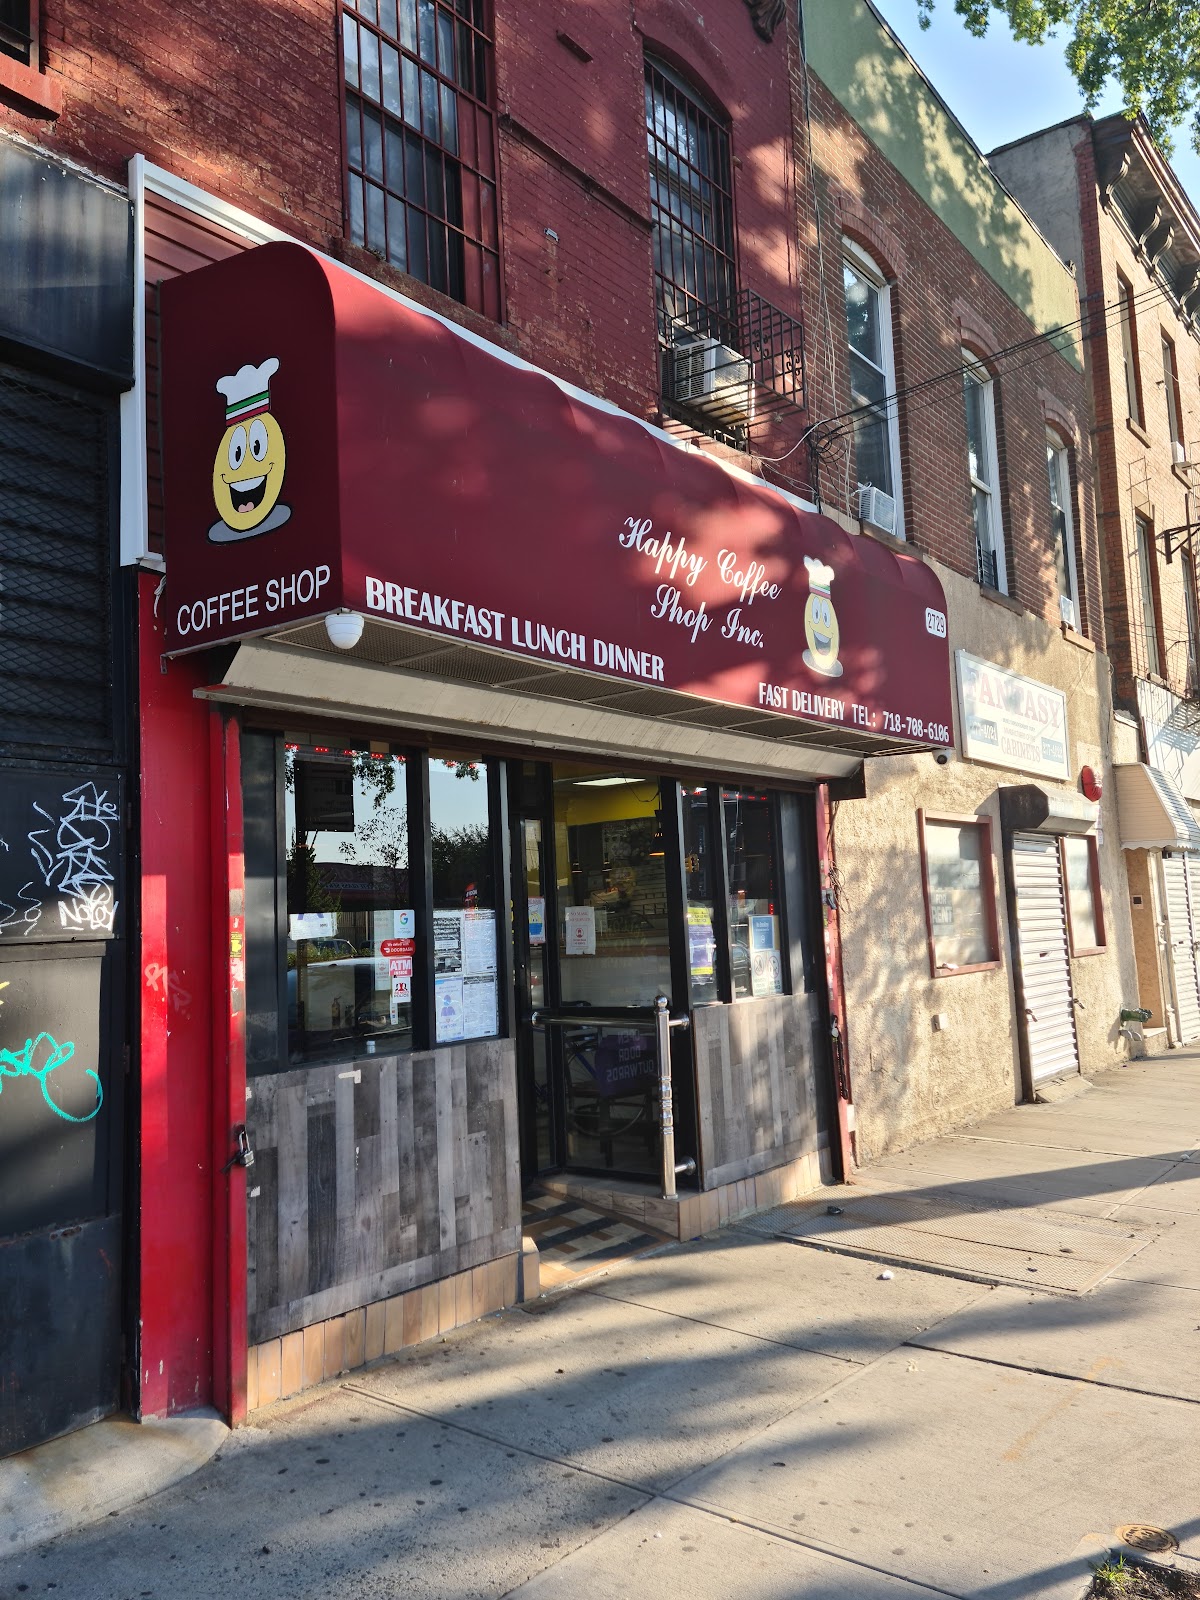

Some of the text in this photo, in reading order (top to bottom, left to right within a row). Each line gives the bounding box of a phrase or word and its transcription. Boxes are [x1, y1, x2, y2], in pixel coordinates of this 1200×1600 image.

[618, 516, 782, 604] Happy Coffee
[177, 565, 331, 635] COFFEE SHOP
[651, 584, 764, 648] Shop Inc.
[927, 612, 945, 633] 2729
[365, 575, 665, 682] BREAKFAST LUNCH DINNER
[758, 682, 789, 710] FAST
[792, 689, 846, 721] DELIVERY
[851, 703, 877, 728] TEL:
[965, 666, 1062, 729] FANTASY
[1001, 736, 1041, 763] CABINETS
[932, 906, 953, 923] RENT
[935, 893, 947, 904] FOR
[390, 959, 411, 971] ATM
